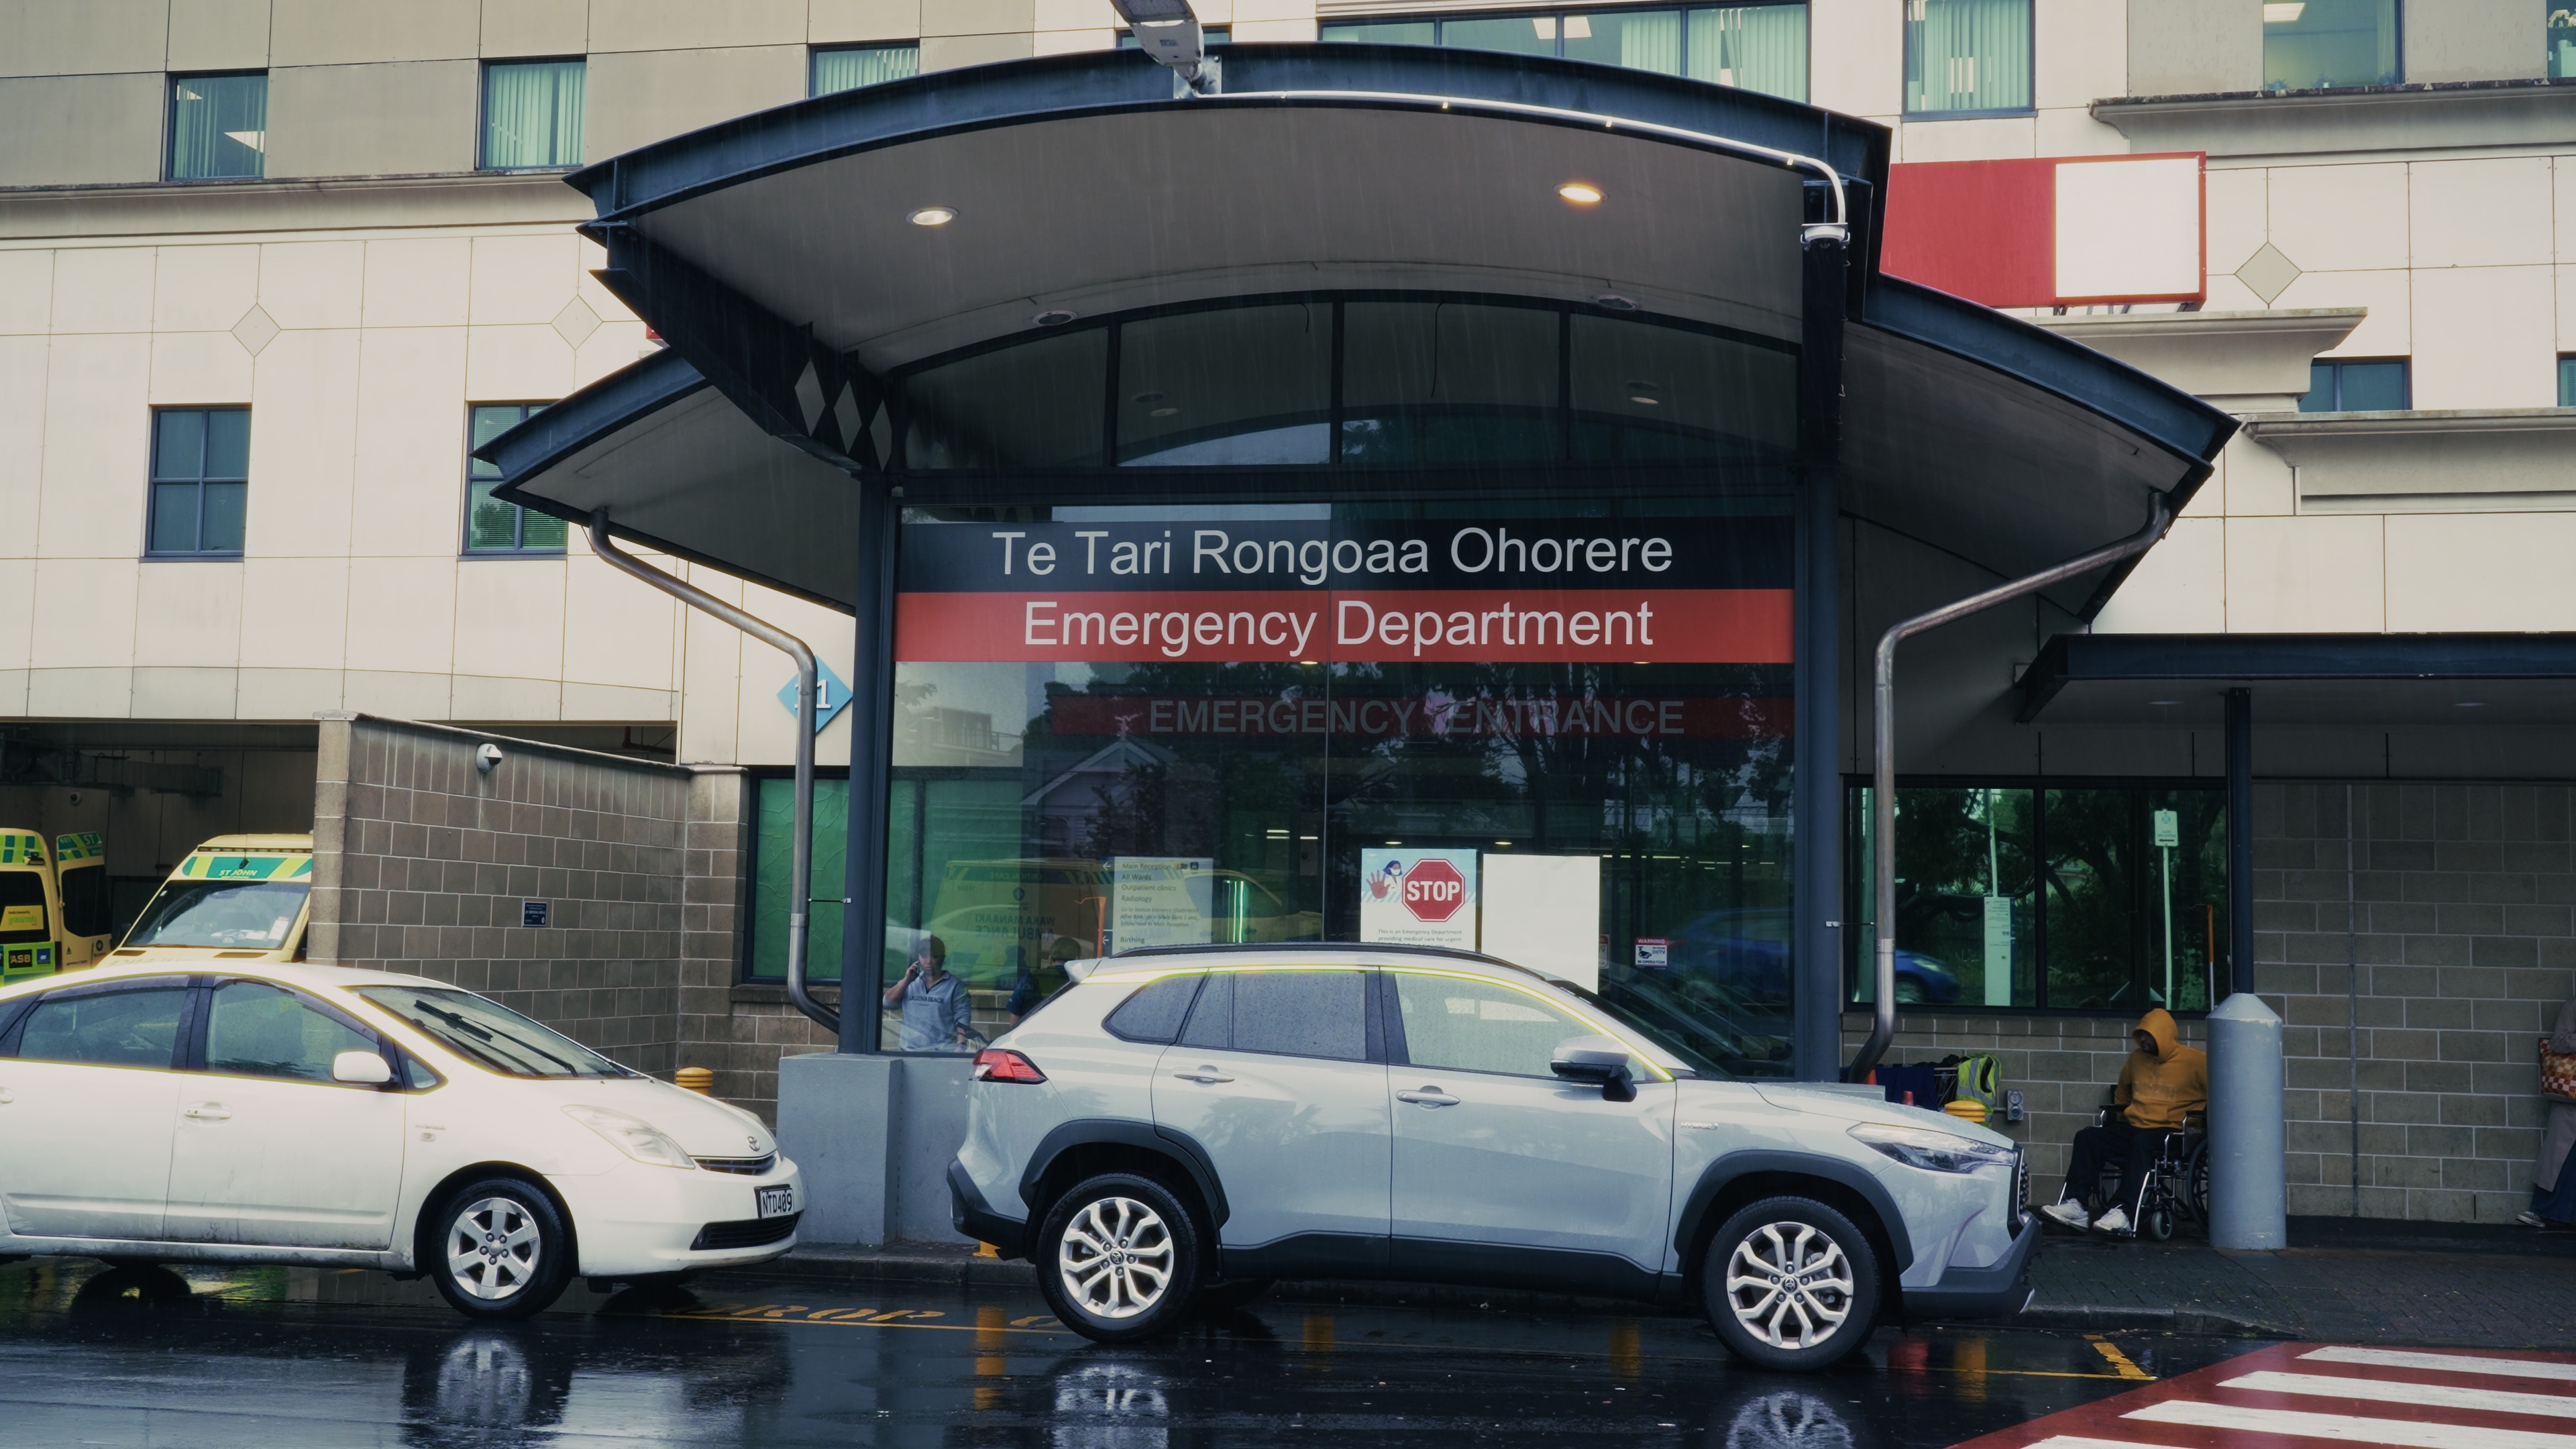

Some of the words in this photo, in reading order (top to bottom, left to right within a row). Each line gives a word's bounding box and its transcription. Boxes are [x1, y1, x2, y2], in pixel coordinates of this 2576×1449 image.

[992, 531, 1056, 576] Te
[1075, 530, 1171, 575] Tari
[1193, 530, 1428, 586] Rongoaa
[1451, 527, 1672, 573] Ohorere
[1024, 601, 1318, 657] Emergency
[1338, 600, 1654, 657] Department
[794, 679, 832, 709] 1
[1149, 700, 1417, 734] EMERGENCY
[1448, 700, 1685, 734] ENTRANCE
[1140, 863, 1171, 871] Reception
[1121, 895, 1152, 903] Radiology
[1407, 880, 1460, 902] STOP
[1120, 936, 1145, 945] Birthing
[10, 954, 31, 964] ASB
[762, 1193, 792, 1215] NTD409
